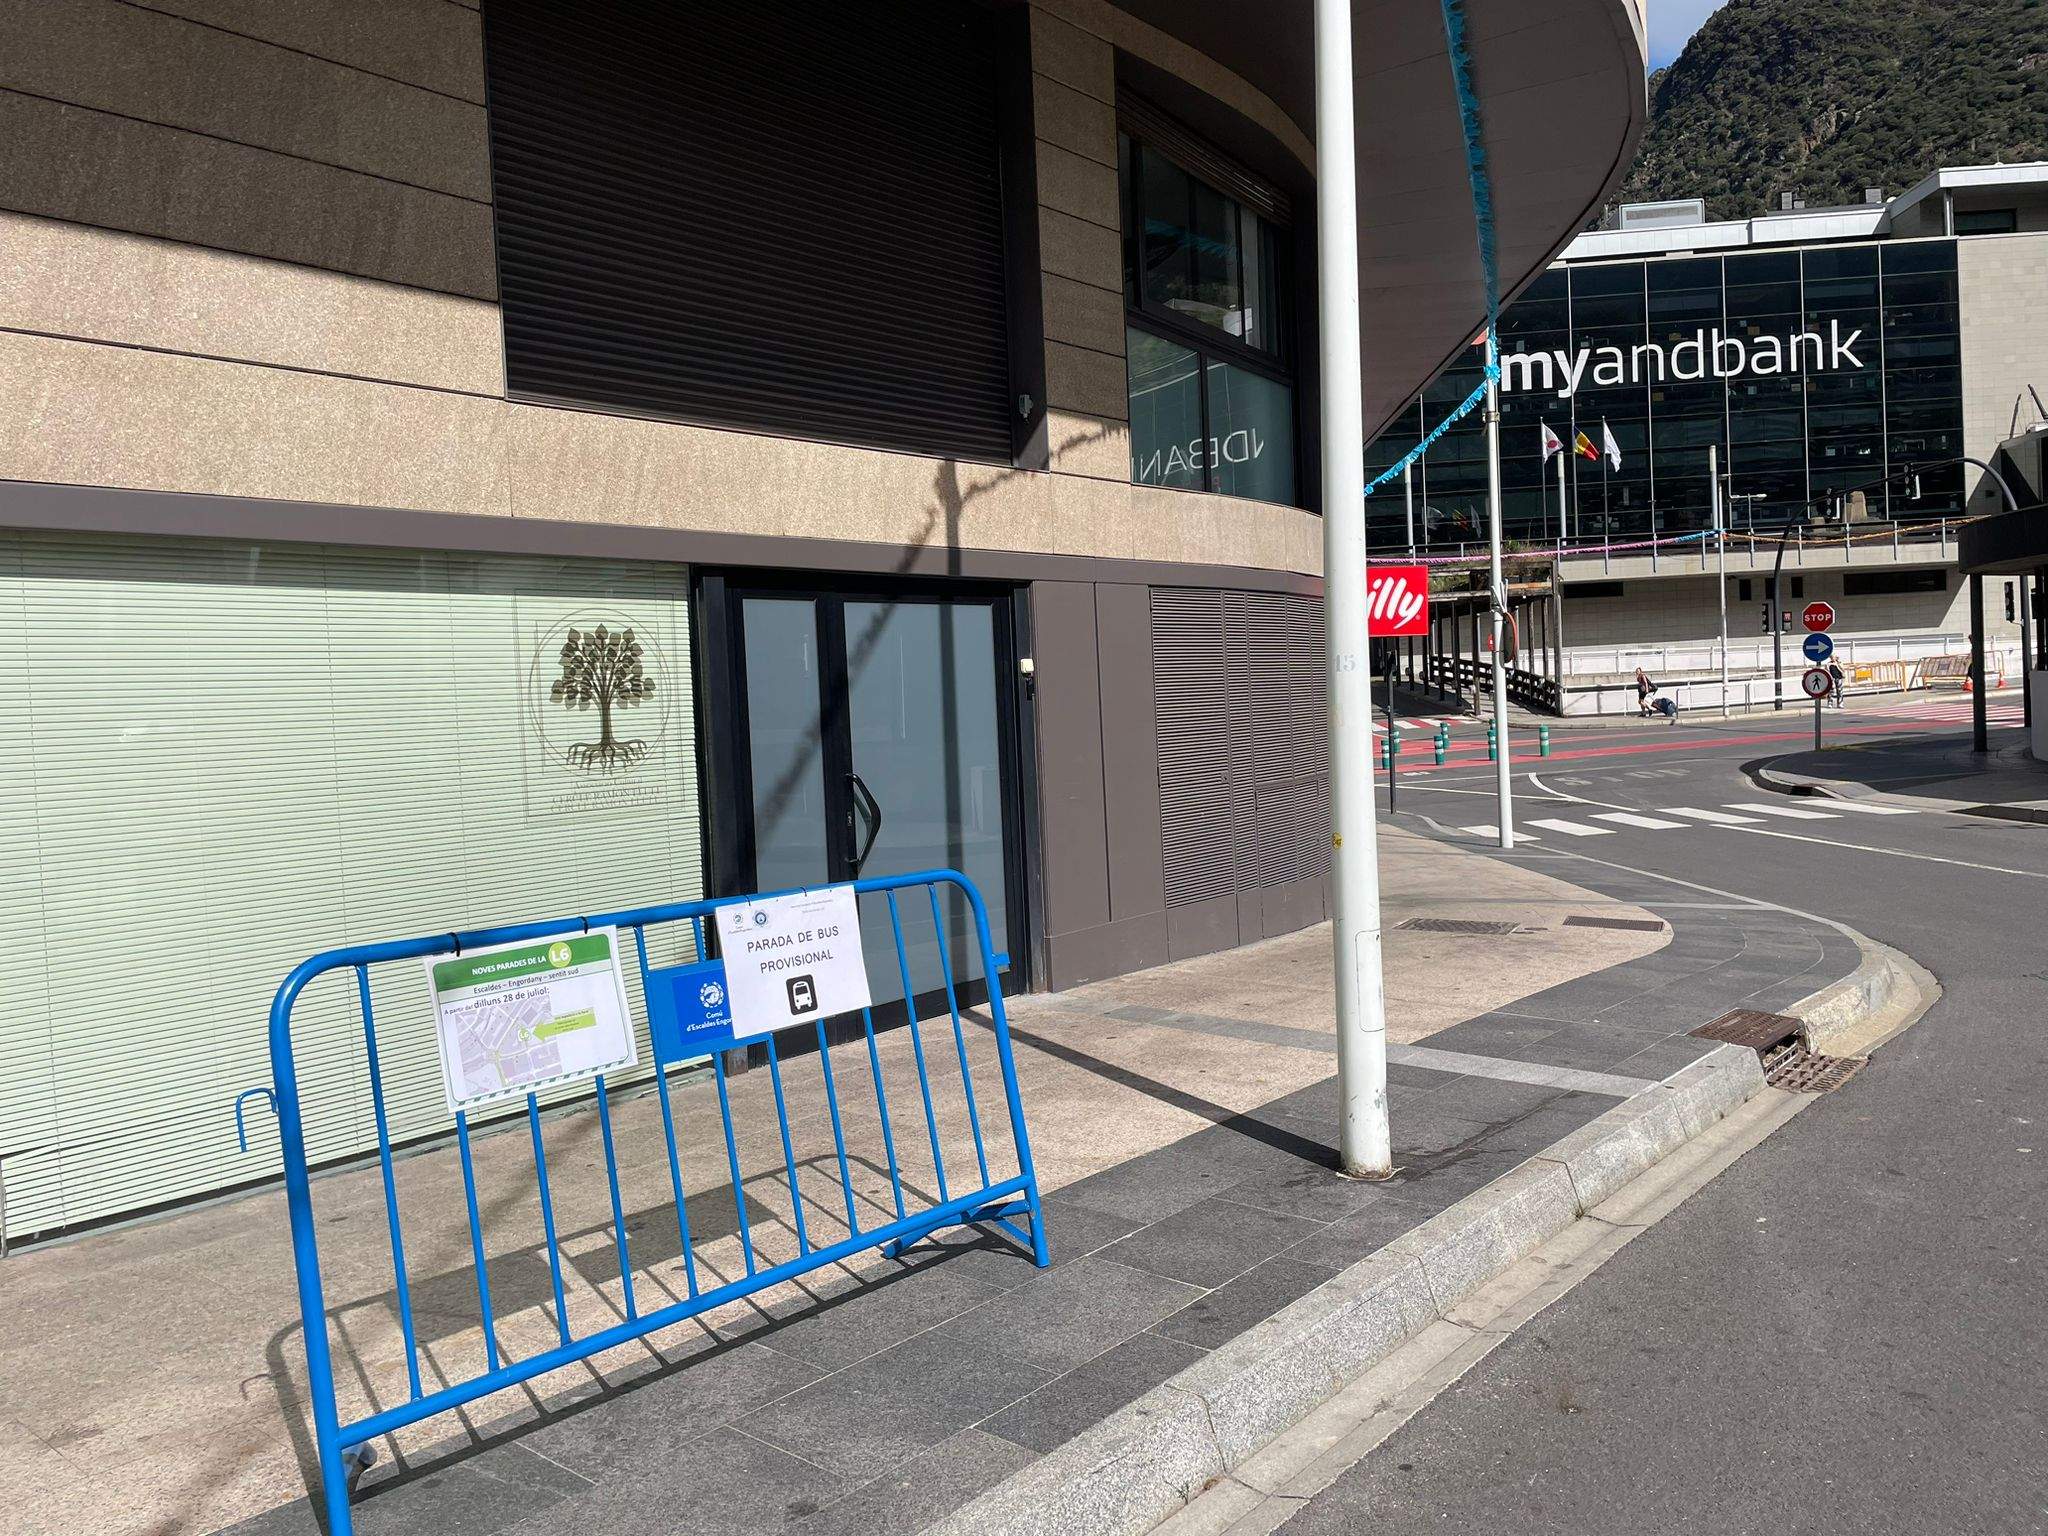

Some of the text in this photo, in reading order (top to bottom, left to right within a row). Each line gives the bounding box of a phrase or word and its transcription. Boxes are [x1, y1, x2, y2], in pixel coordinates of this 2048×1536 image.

[1500, 318, 1864, 398] myandbank
[1366, 576, 1424, 629] illy
[1804, 613, 1832, 622] STOP
[747, 925, 840, 953] PARADA DE BUS
[472, 947, 570, 976] NOVES PARADES DE LA L6
[760, 950, 834, 974] PROVISIONAL
[473, 981, 502, 994] Escaldes
[508, 974, 543, 988] Engordany
[549, 970, 567, 980] sentit
[567, 968, 579, 976] sud
[473, 995, 502, 1010] dilluns
[502, 993, 514, 1003] 28
[515, 991, 526, 1001] de
[526, 987, 550, 999] juliol:
